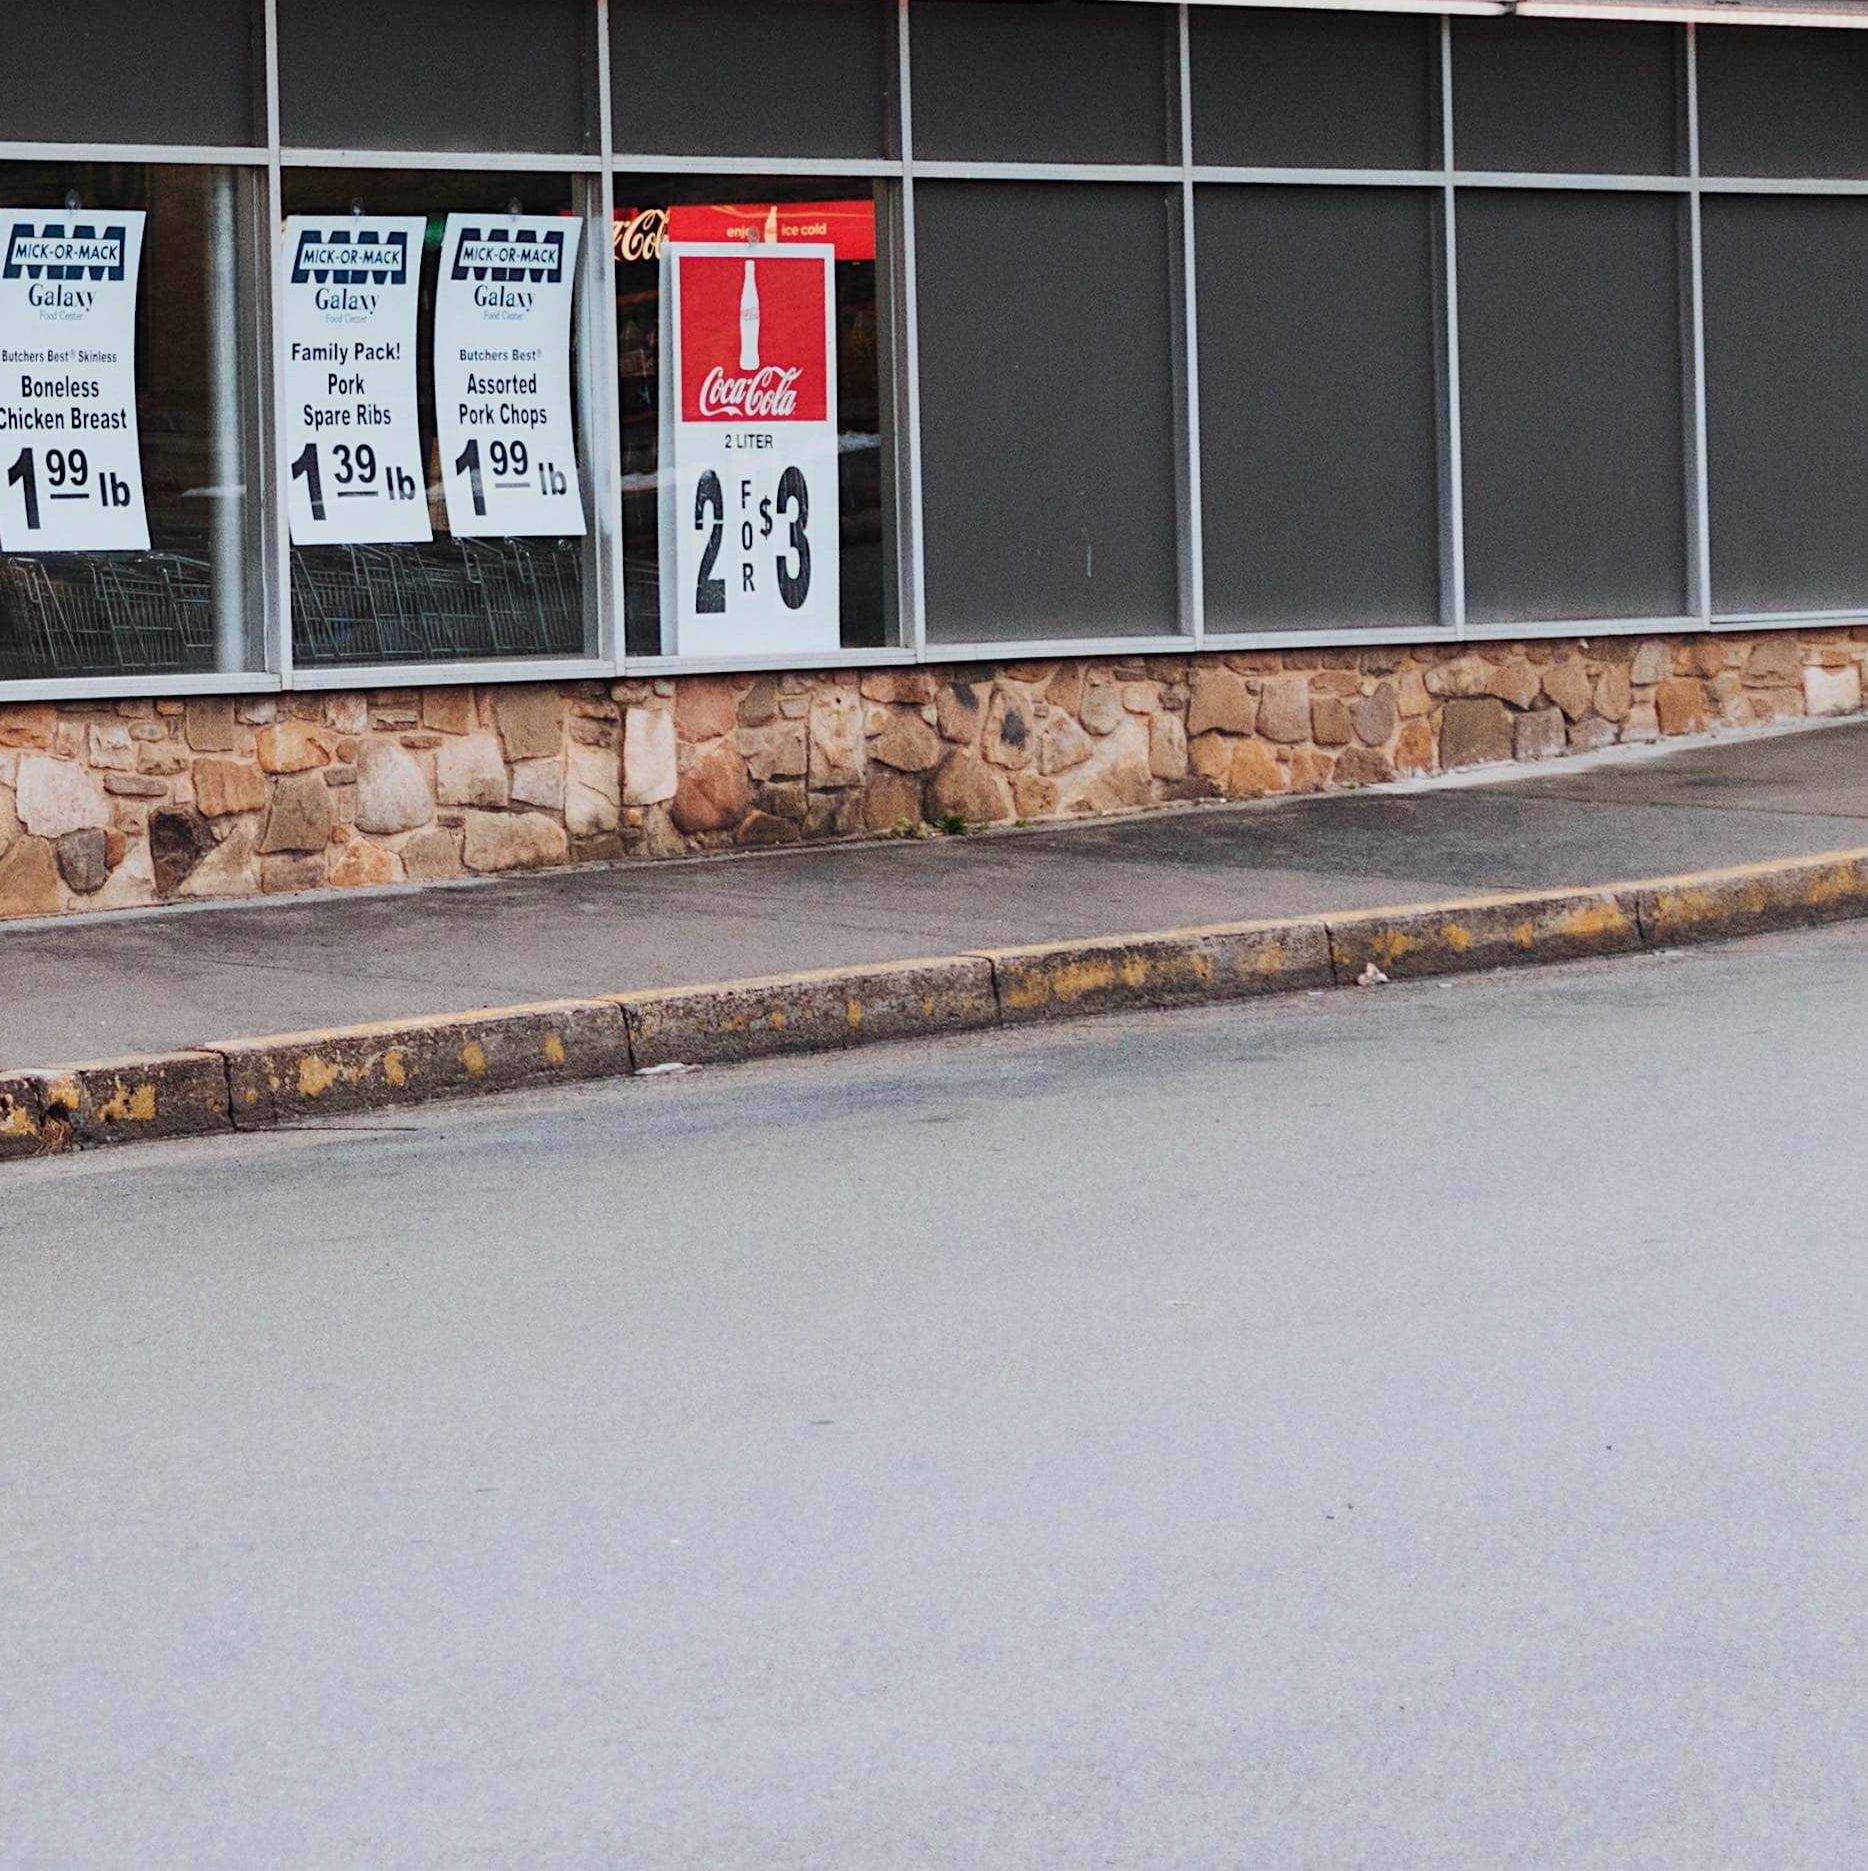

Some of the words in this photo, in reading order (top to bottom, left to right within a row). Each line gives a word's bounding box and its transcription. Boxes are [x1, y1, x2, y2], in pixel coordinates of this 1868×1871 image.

[781, 223, 799, 237] ice
[800, 223, 827, 236] cold
[15, 243, 118, 261] MICK-OR-MACK
[303, 249, 400, 265] MICK-OR-MACK
[463, 246, 557, 264] MICK-OR-MACK
[28, 282, 96, 312] Galaxy
[315, 287, 379, 315] Galaxy
[473, 284, 535, 312] Galaxy
[1, 349, 44, 363] Butchers
[78, 350, 118, 363] Skinless
[291, 342, 349, 365] Family
[354, 342, 401, 361] Pack!
[459, 349, 509, 361] Butchers
[21, 375, 99, 398] Boneless
[328, 373, 365, 395] Pork
[467, 372, 537, 395] Assorted
[698, 365, 803, 417] Coca-Cola
[70, 407, 128, 430] Breast
[303, 404, 351, 431] Spare
[357, 403, 392, 425] Ribs
[459, 403, 495, 425] Pork
[499, 403, 548, 430] Chops
[724, 434, 732, 449] 2
[736, 434, 773, 449] LITER
[98, 472, 131, 507] lb
[385, 466, 416, 501] lb
[538, 462, 567, 496] lb
[694, 468, 726, 615] 2
[741, 480, 755, 592] FOR
